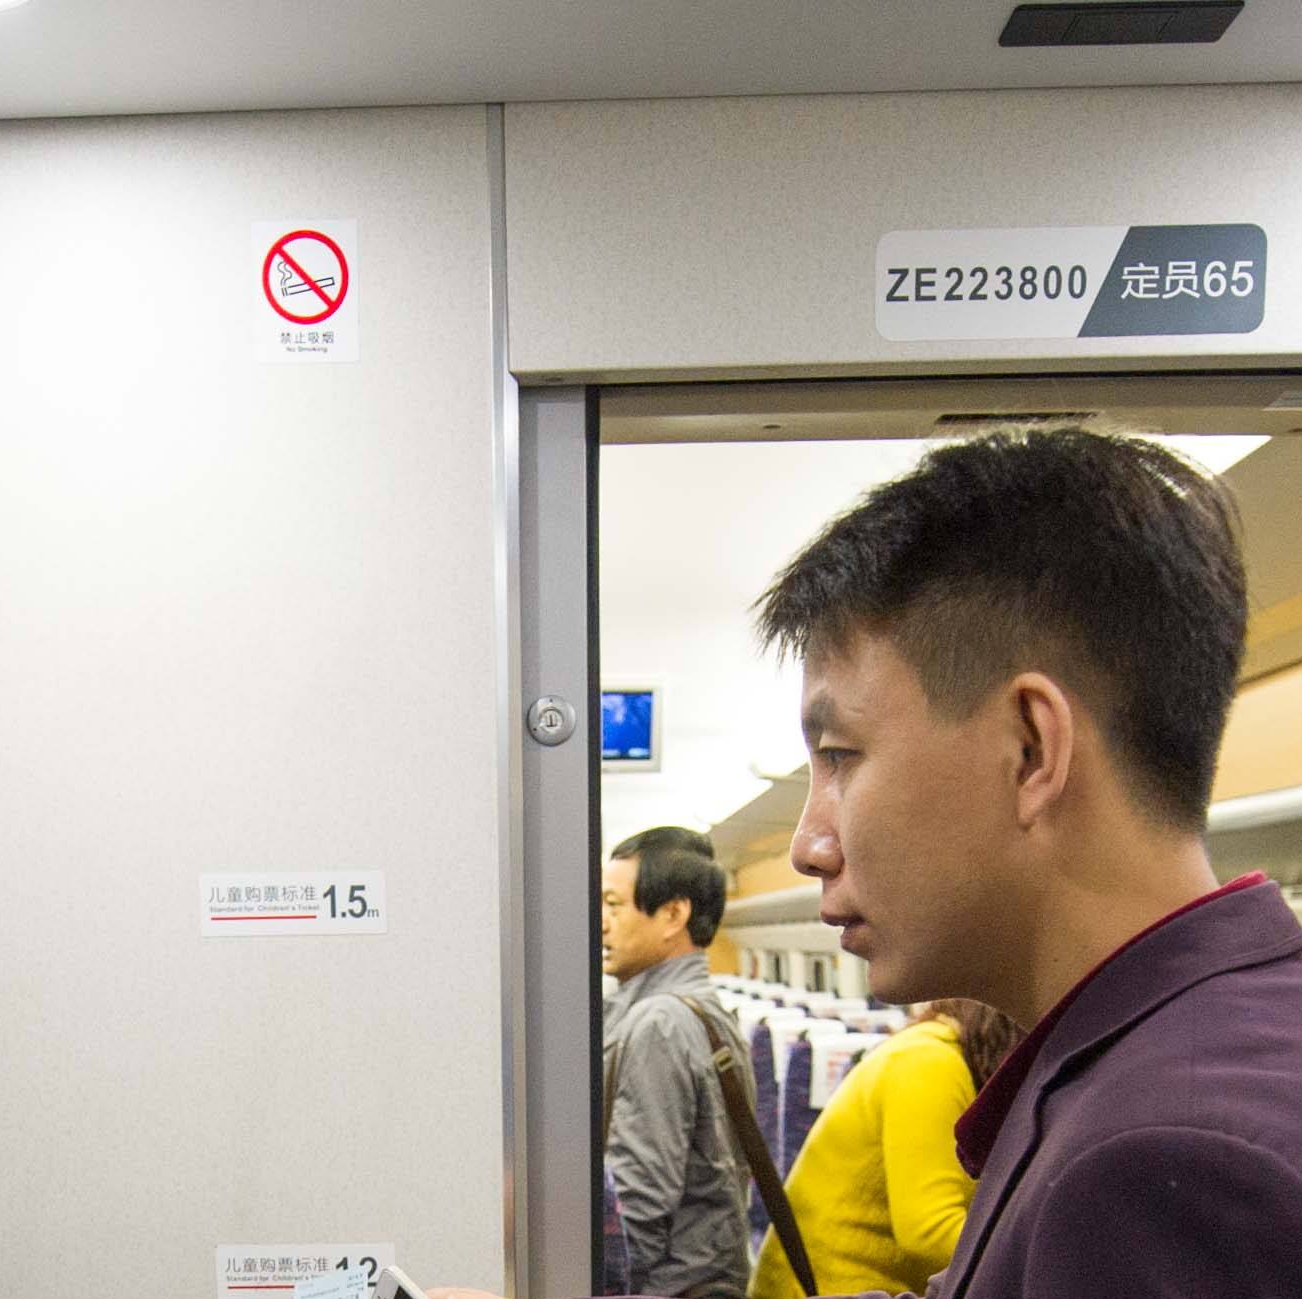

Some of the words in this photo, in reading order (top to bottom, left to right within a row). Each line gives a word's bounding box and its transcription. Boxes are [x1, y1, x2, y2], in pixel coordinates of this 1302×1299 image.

[885, 264, 1088, 302] ZE223800
[1120, 260, 1255, 300] 定员65
[208, 885, 317, 904] 儿童购票标准
[225, 1256, 330, 1273] 儿童购票标准
